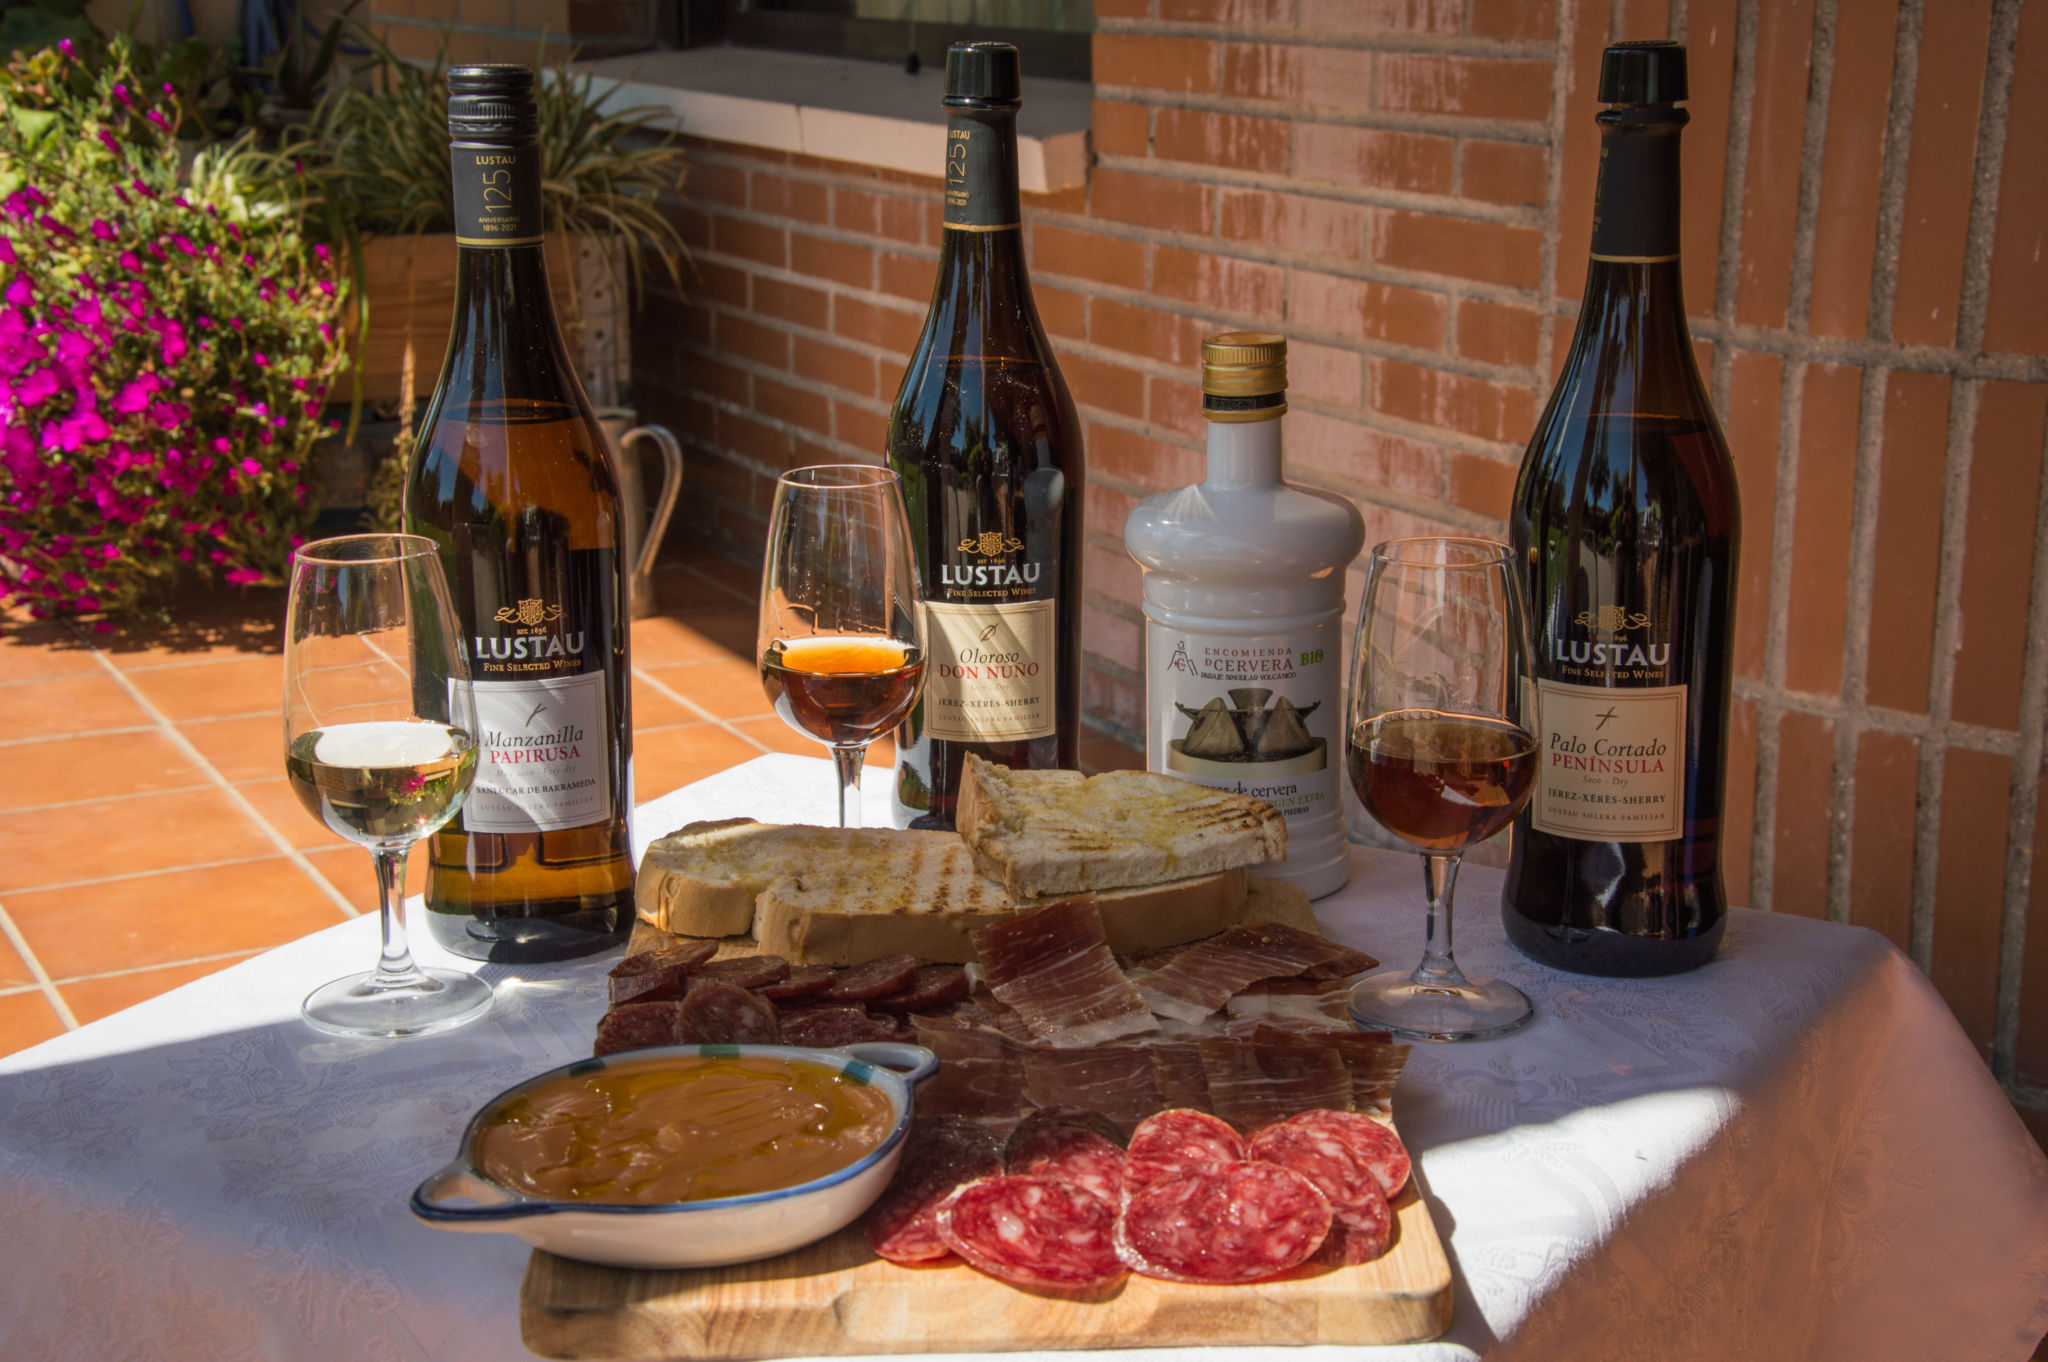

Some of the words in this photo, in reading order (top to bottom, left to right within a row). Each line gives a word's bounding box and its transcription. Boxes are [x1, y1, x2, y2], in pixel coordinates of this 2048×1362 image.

[475, 155, 516, 165] LUSTAU
[948, 144, 966, 186] 125
[483, 169, 512, 213] 125
[941, 562, 1041, 585] LUSTAU
[947, 587, 966, 597] FINE
[968, 588, 1008, 597] SELECTED
[475, 631, 585, 660] LUSTAU
[1205, 647, 1293, 657] ENCOMIENDA
[1557, 638, 1671, 666] LUSTAU
[960, 648, 1019, 664] Oloroso
[1300, 648, 1325, 666] BIO
[483, 662, 504, 672] FINE
[507, 661, 550, 672] SELECTED
[553, 658, 581, 668] WINES
[940, 663, 978, 680] DON
[987, 661, 1039, 680] NUÑO
[1562, 665, 1582, 676] FINE
[1632, 669, 1664, 679] WINES
[485, 724, 584, 748] Manzanilla
[1550, 732, 1586, 754] Palo
[1594, 738, 1667, 757] Cortado
[490, 745, 581, 764] PAPIRUSA
[1552, 753, 1665, 774] PENÍNSULA
[528, 786, 540, 794] DE
[542, 778, 596, 793] BARRAMEDA
[1582, 775, 1602, 784] Seco
[1612, 776, 1630, 788] Dry
[1251, 783, 1298, 798] cervera
[1298, 792, 1325, 805] EXTRA
[1548, 806, 1579, 818] LUSTAU
[1621, 812, 1665, 822] FAMILIAR
